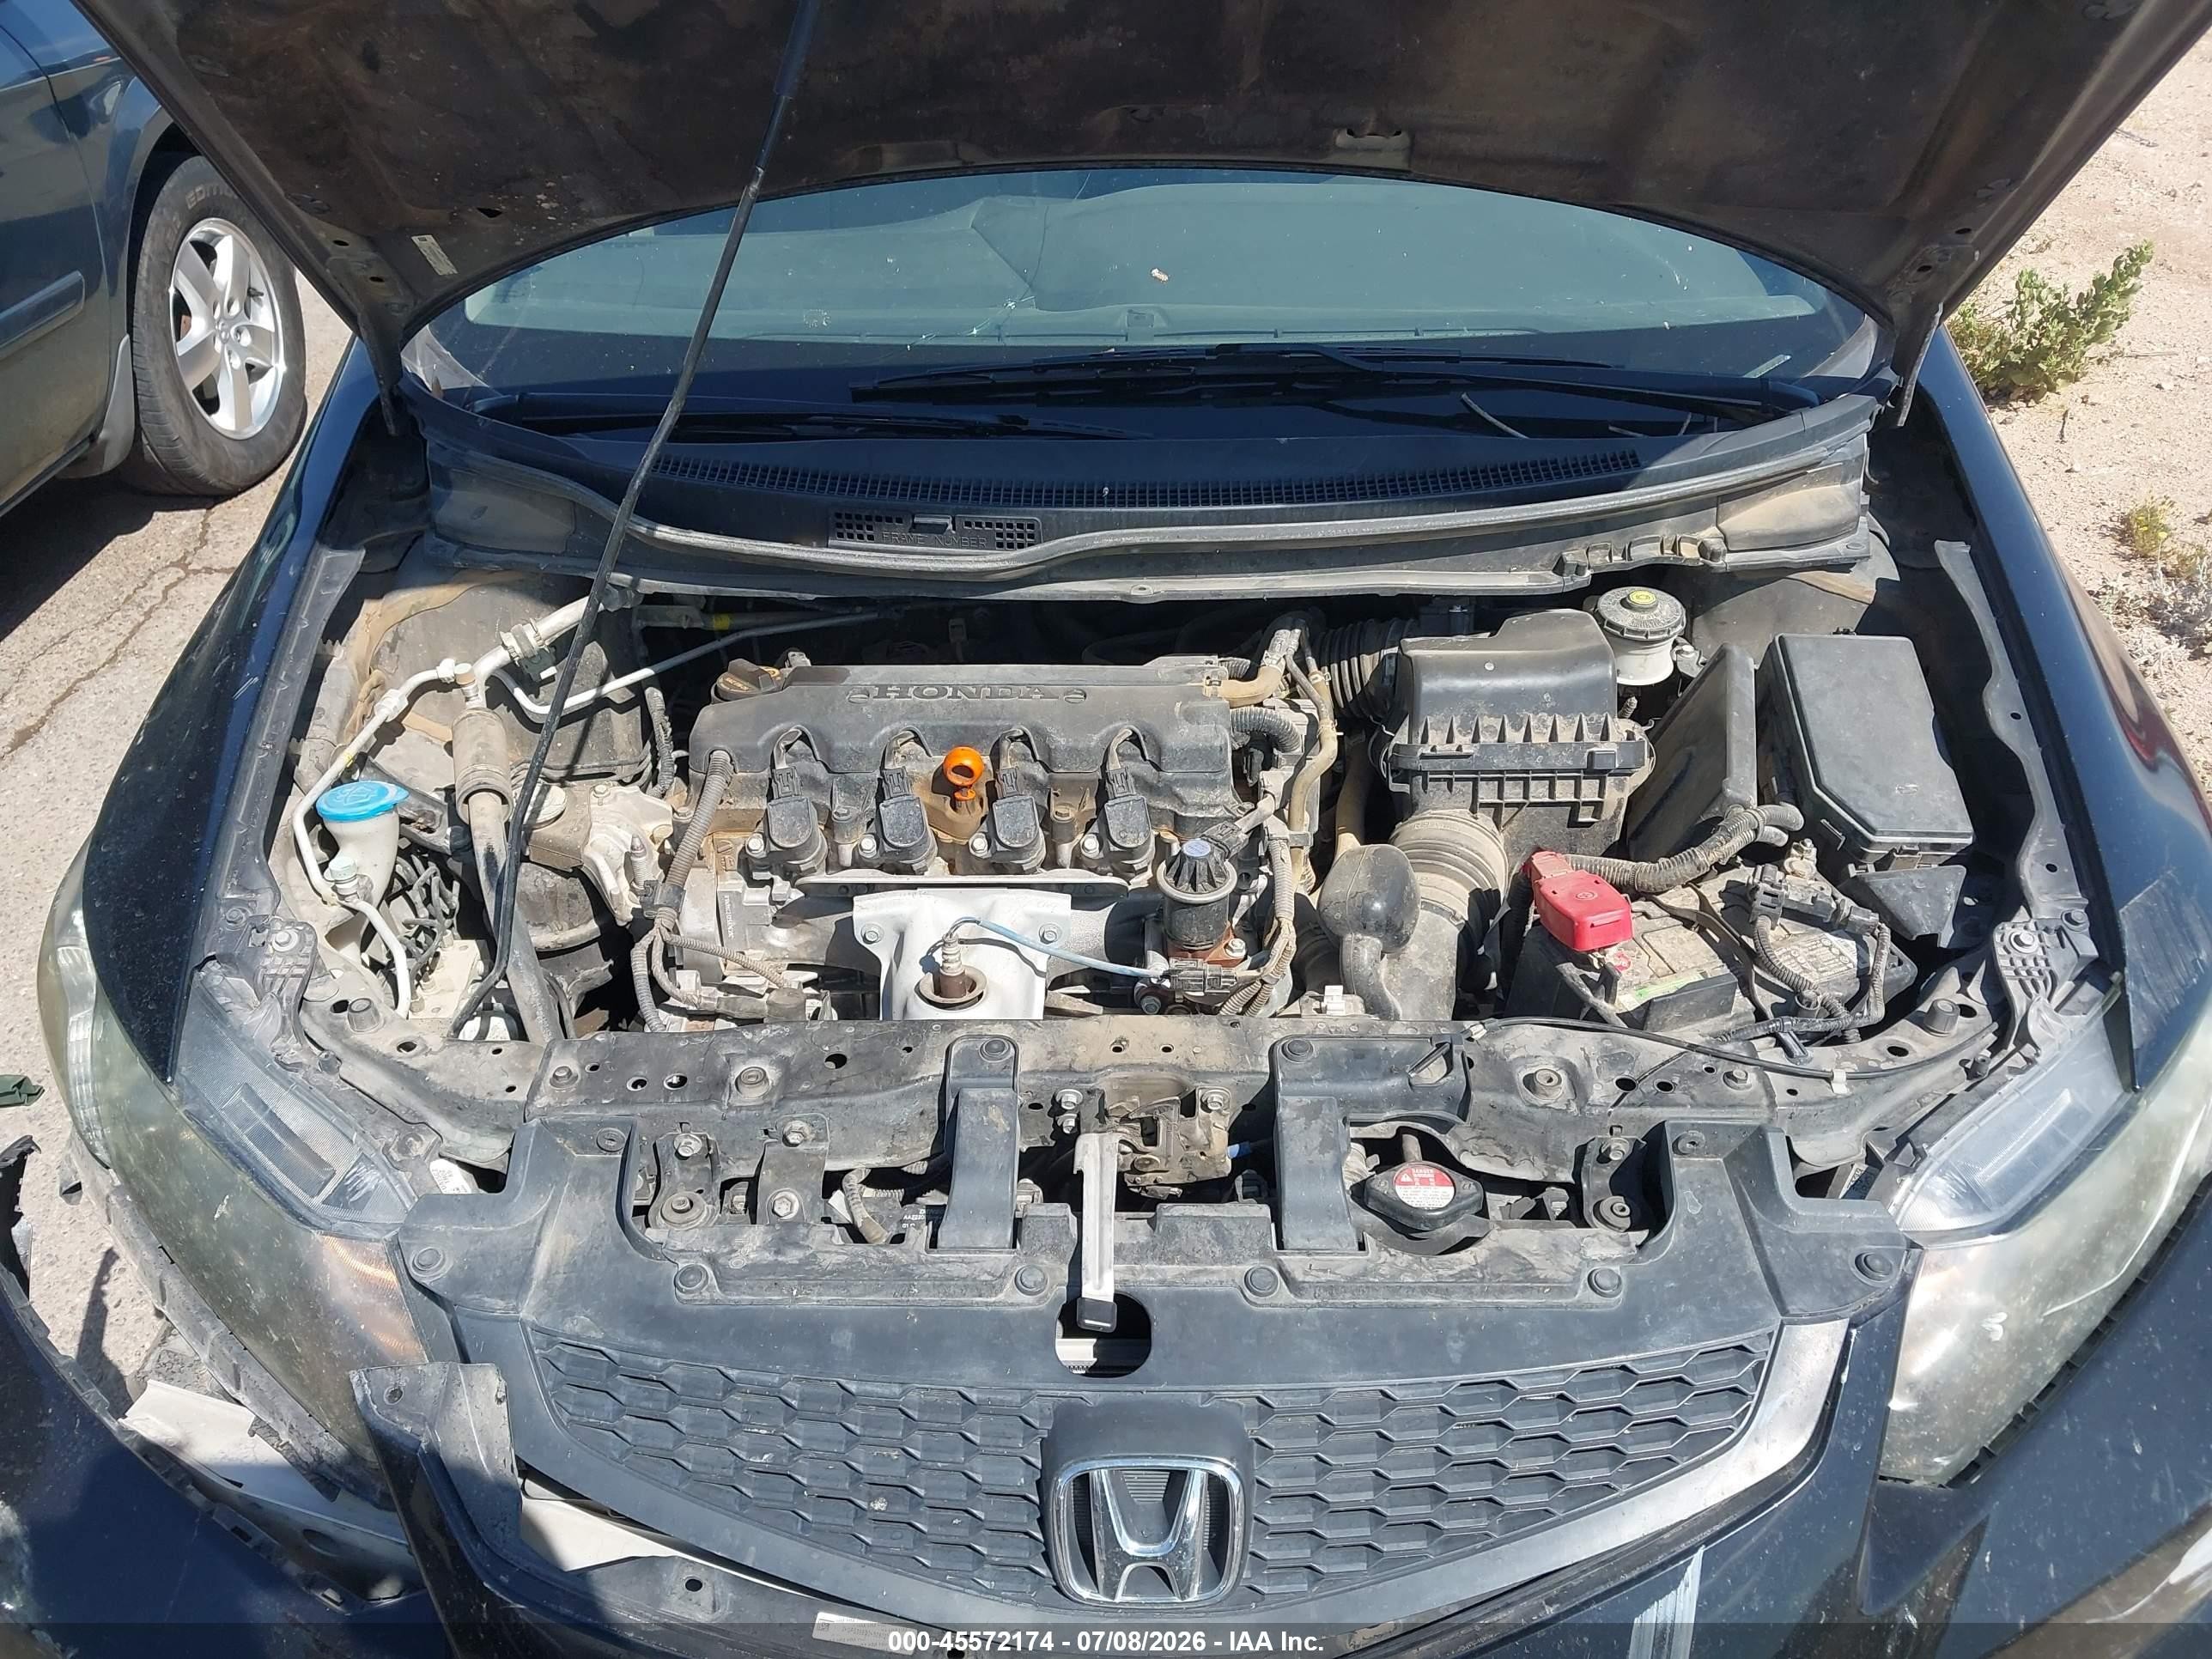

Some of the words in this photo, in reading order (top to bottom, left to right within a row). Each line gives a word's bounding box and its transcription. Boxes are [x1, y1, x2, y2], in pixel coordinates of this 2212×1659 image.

[881, 531, 927, 544] FRAME
[934, 535, 988, 549] NUMBER
[872, 684, 1060, 701] HONDA
